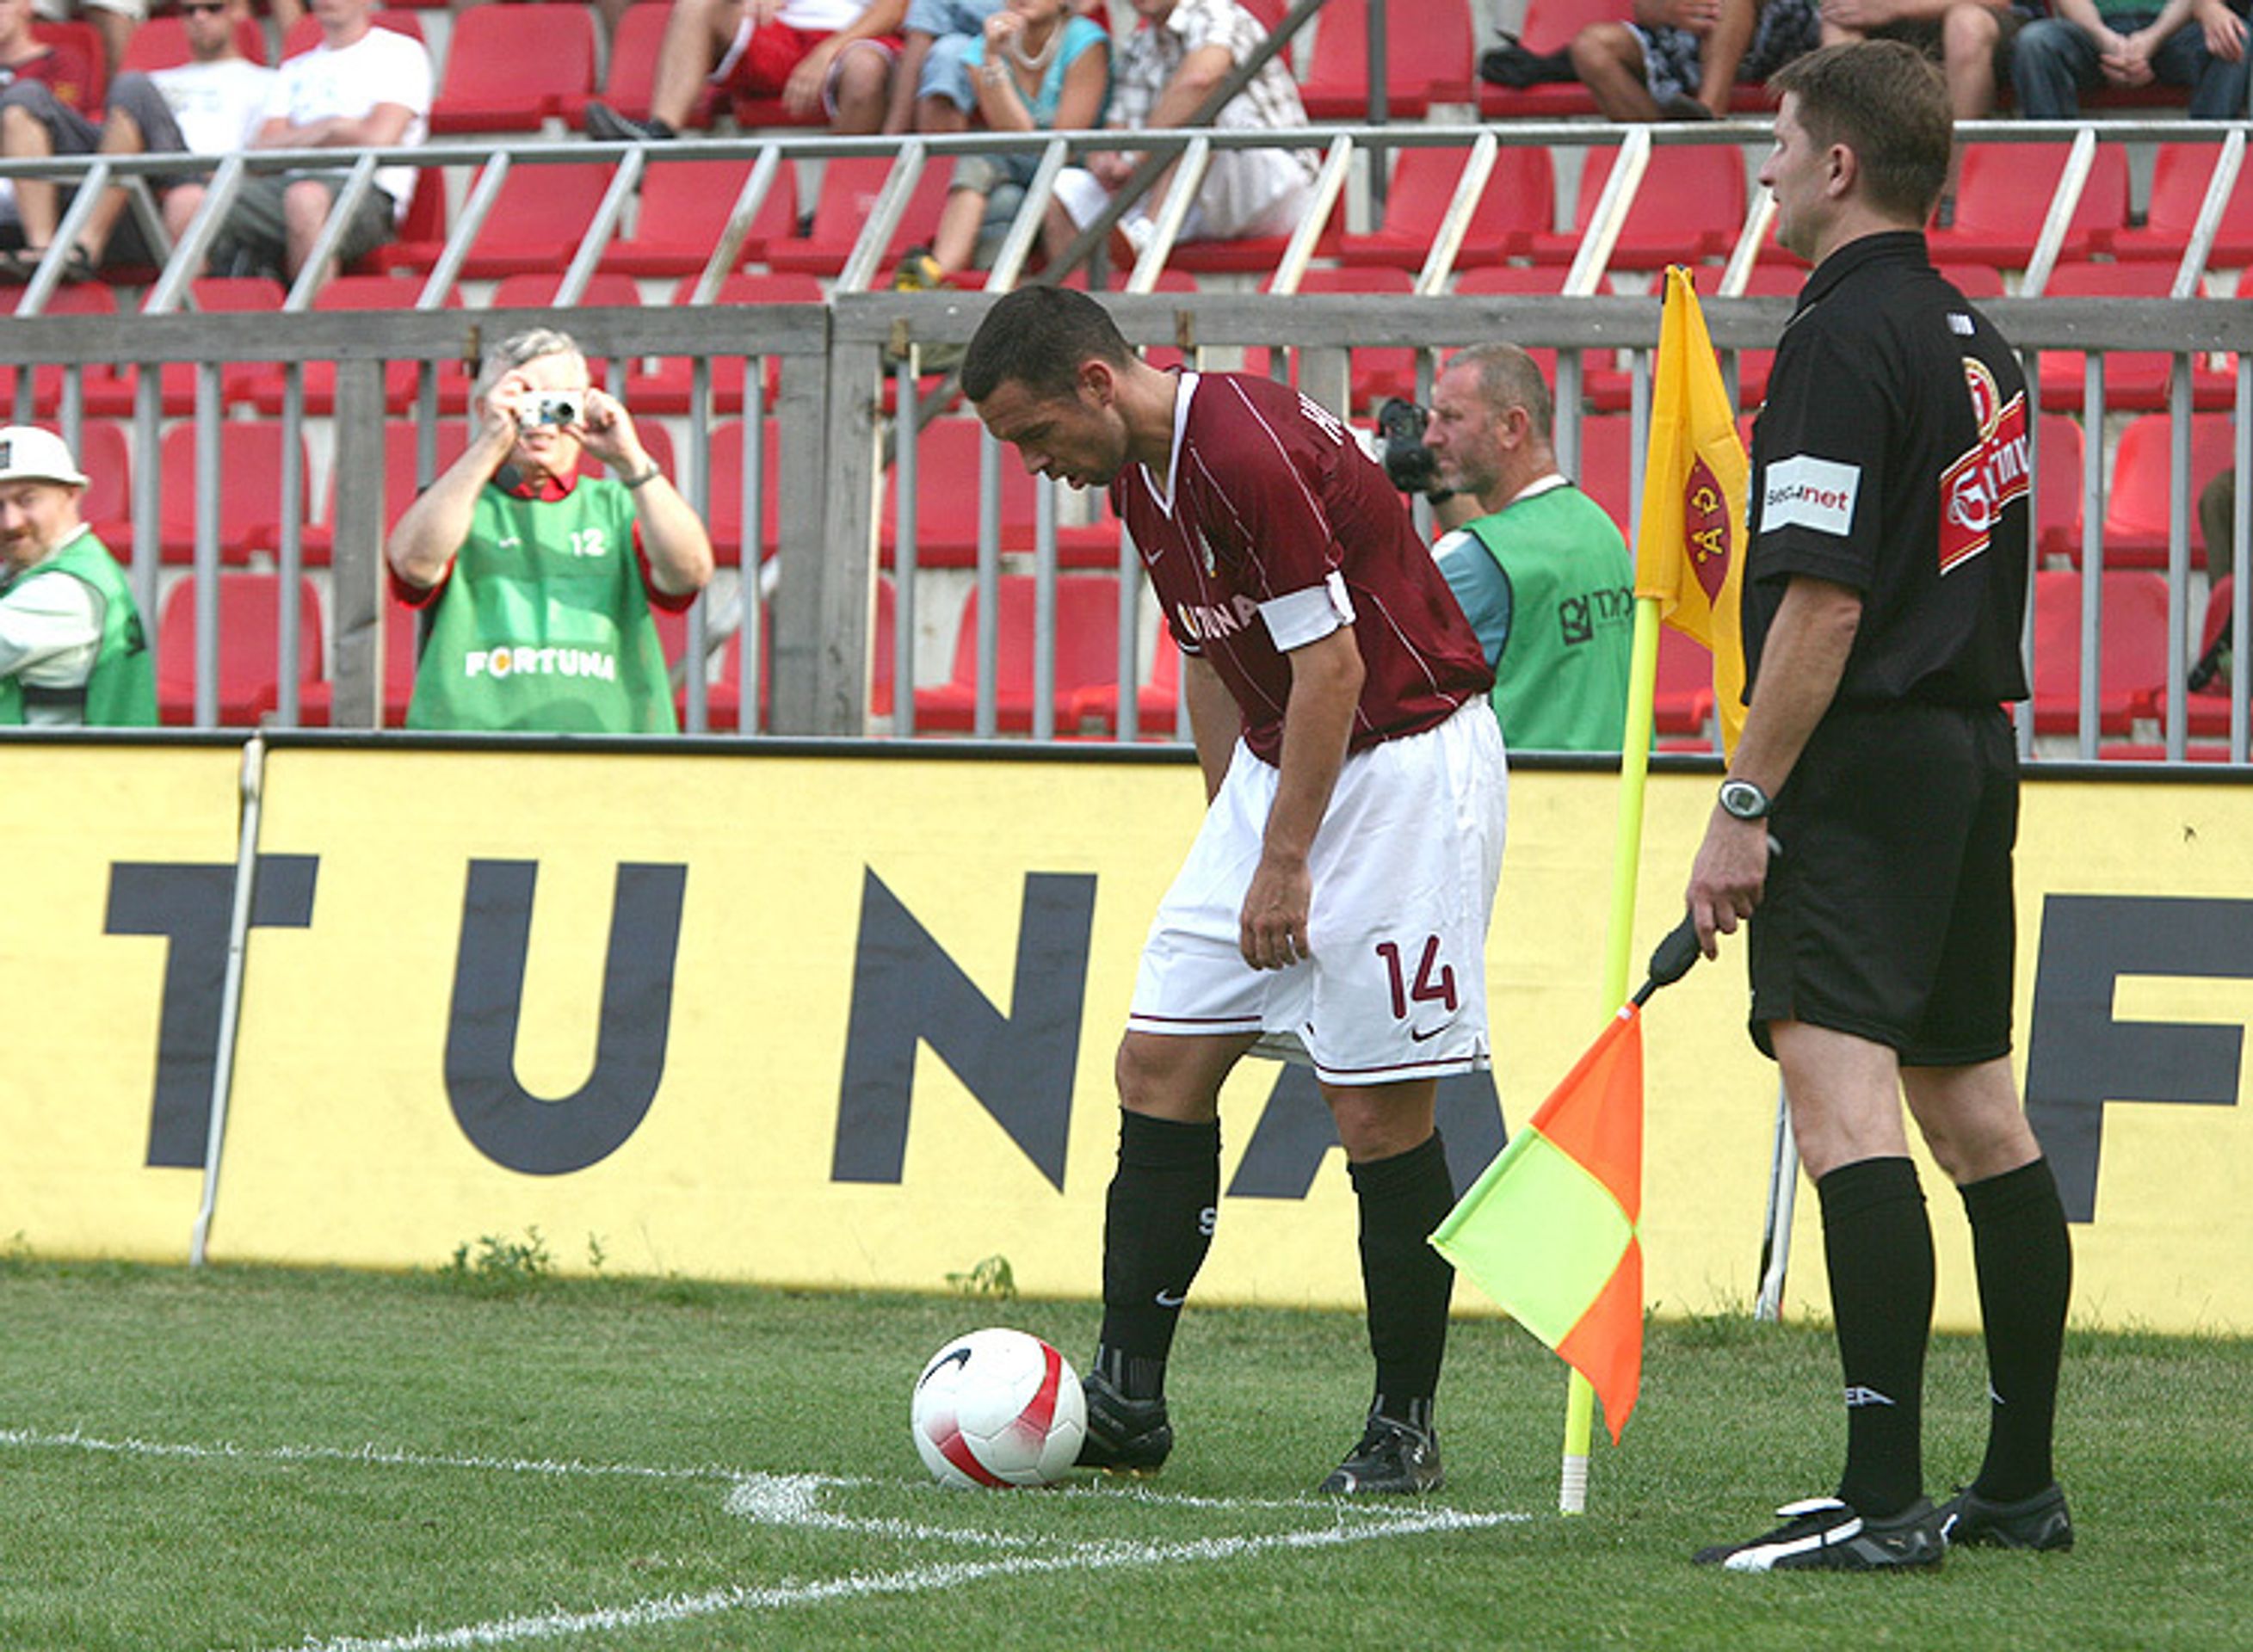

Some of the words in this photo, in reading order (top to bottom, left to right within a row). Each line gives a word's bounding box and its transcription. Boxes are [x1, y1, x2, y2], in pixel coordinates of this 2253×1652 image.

[570, 528, 606, 557] 12
[465, 646, 616, 682] FORTUNA
[1376, 934, 1459, 1020] 14
